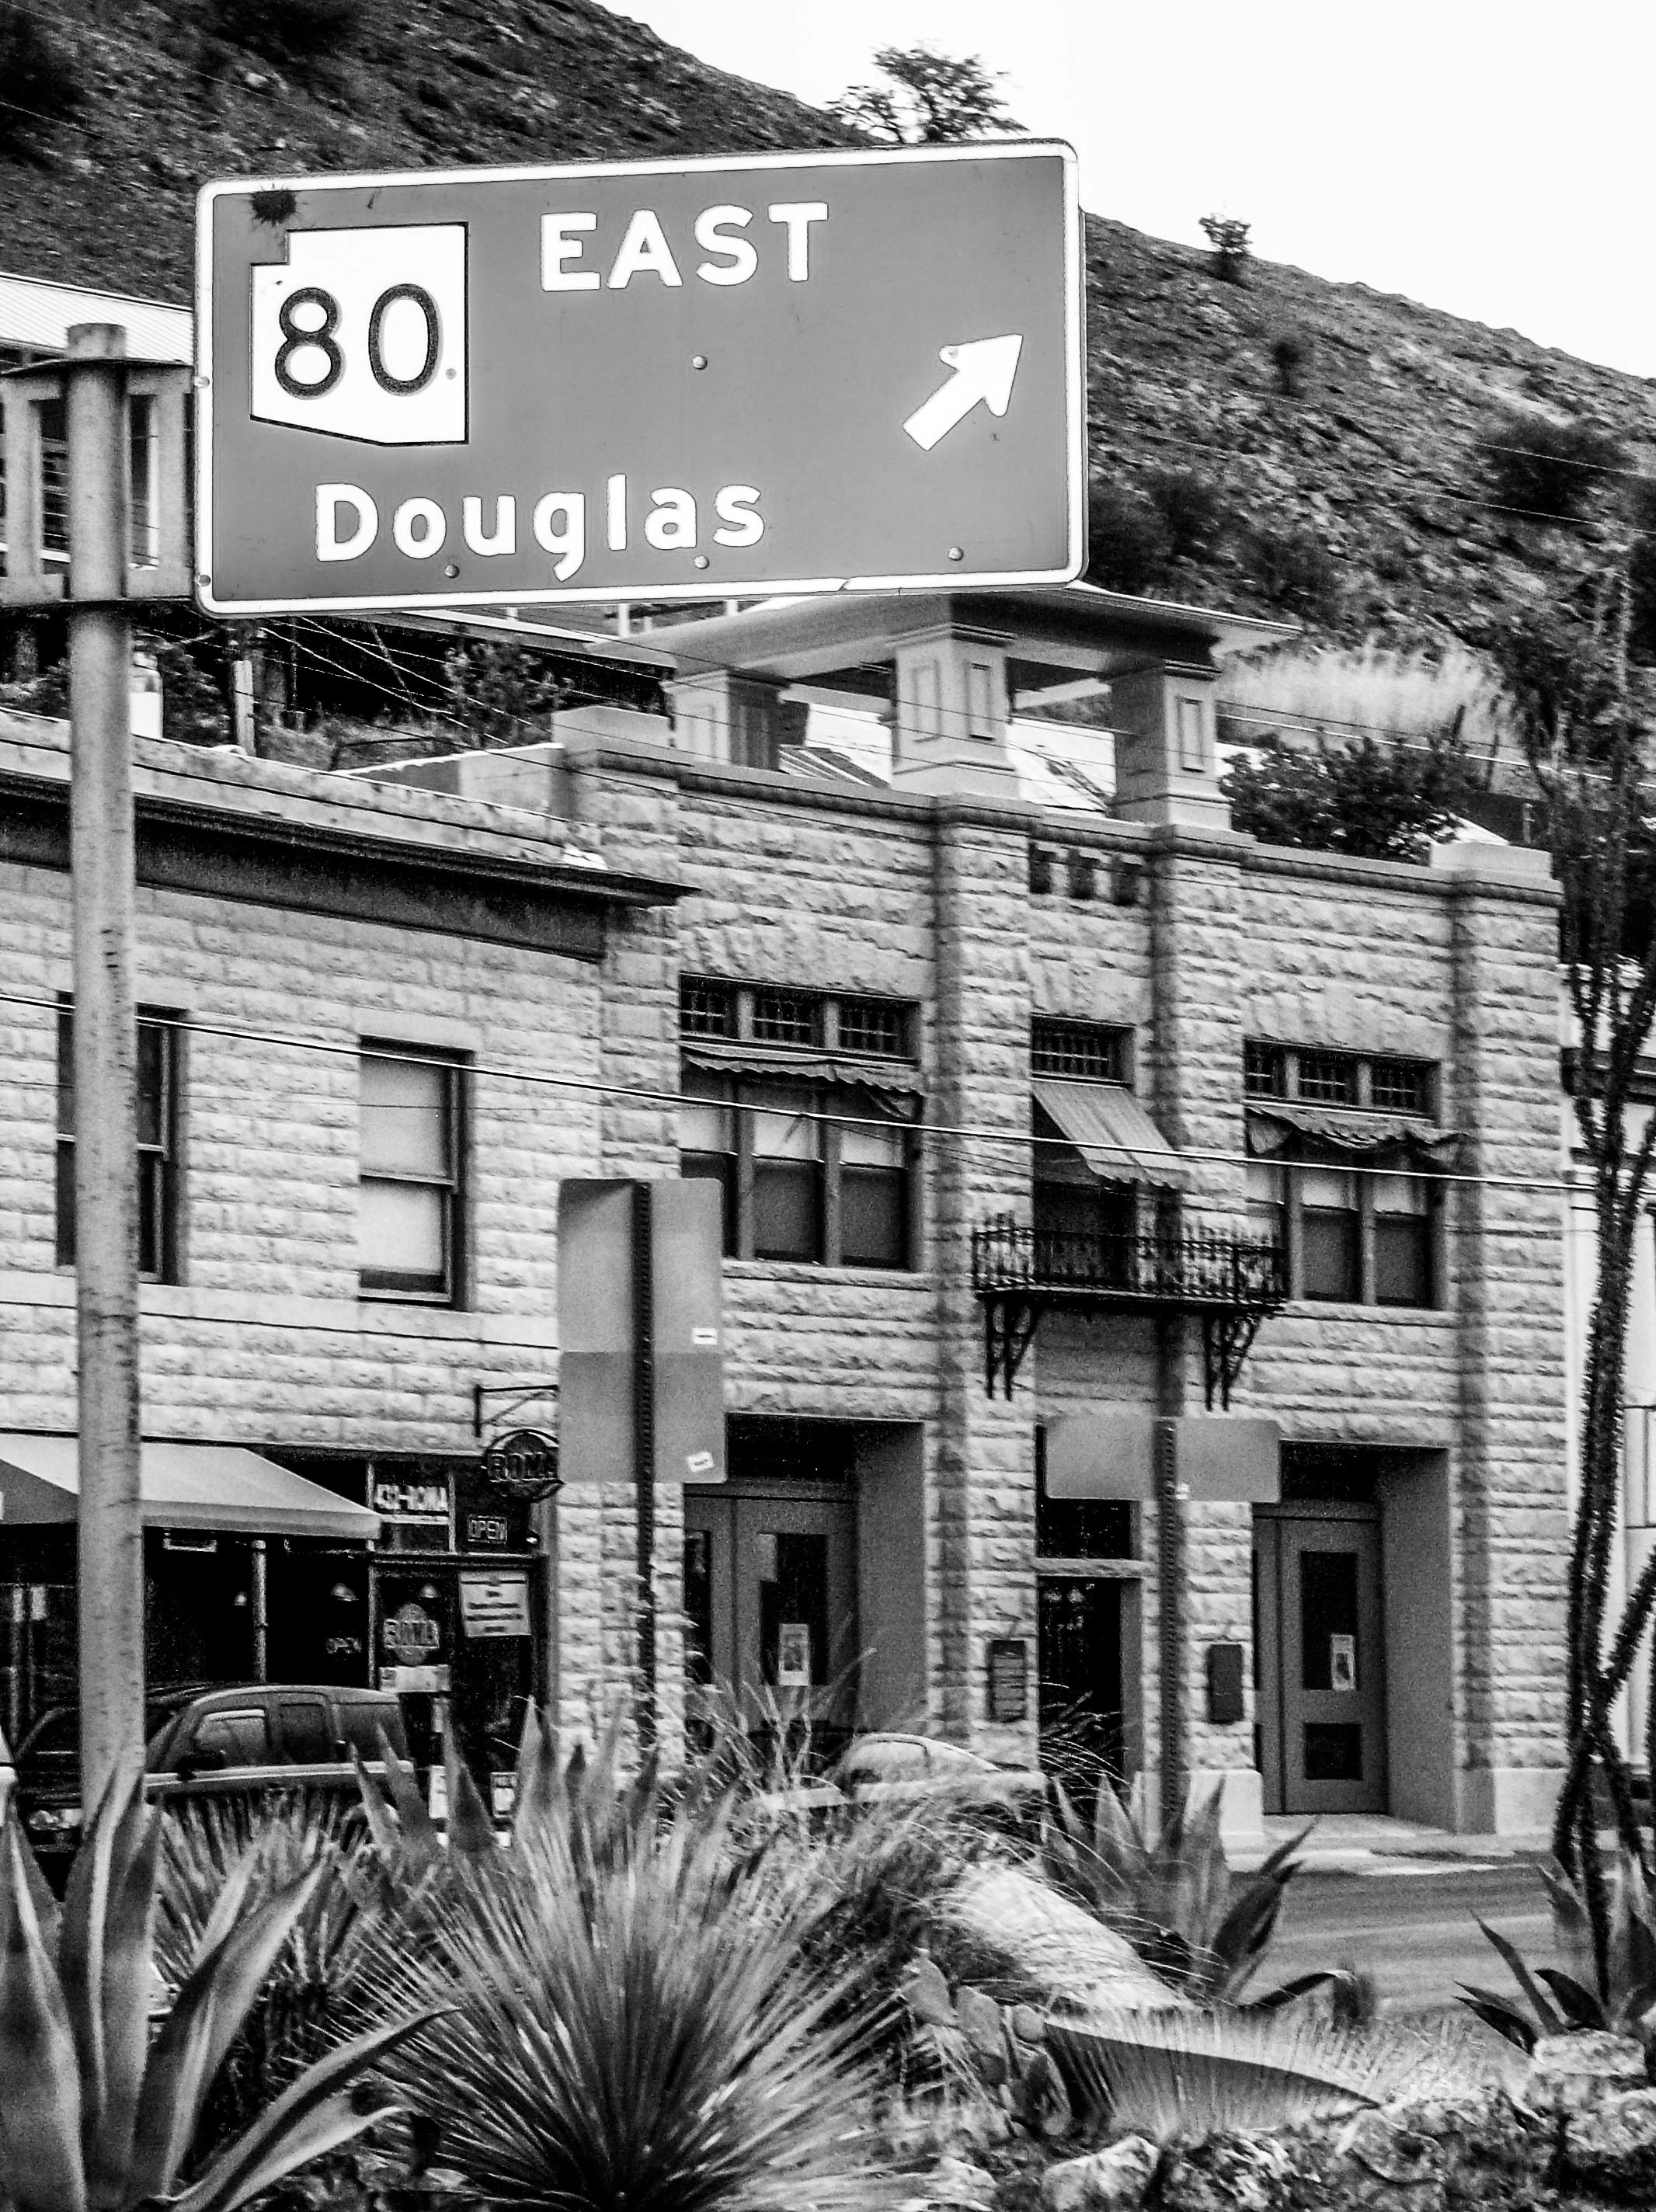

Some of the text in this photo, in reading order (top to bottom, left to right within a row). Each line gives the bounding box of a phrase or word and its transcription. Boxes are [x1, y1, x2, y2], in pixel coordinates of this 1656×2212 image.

[542, 203, 827, 290] EAST
[275, 283, 440, 398] 80
[316, 474, 765, 581] Douglas
